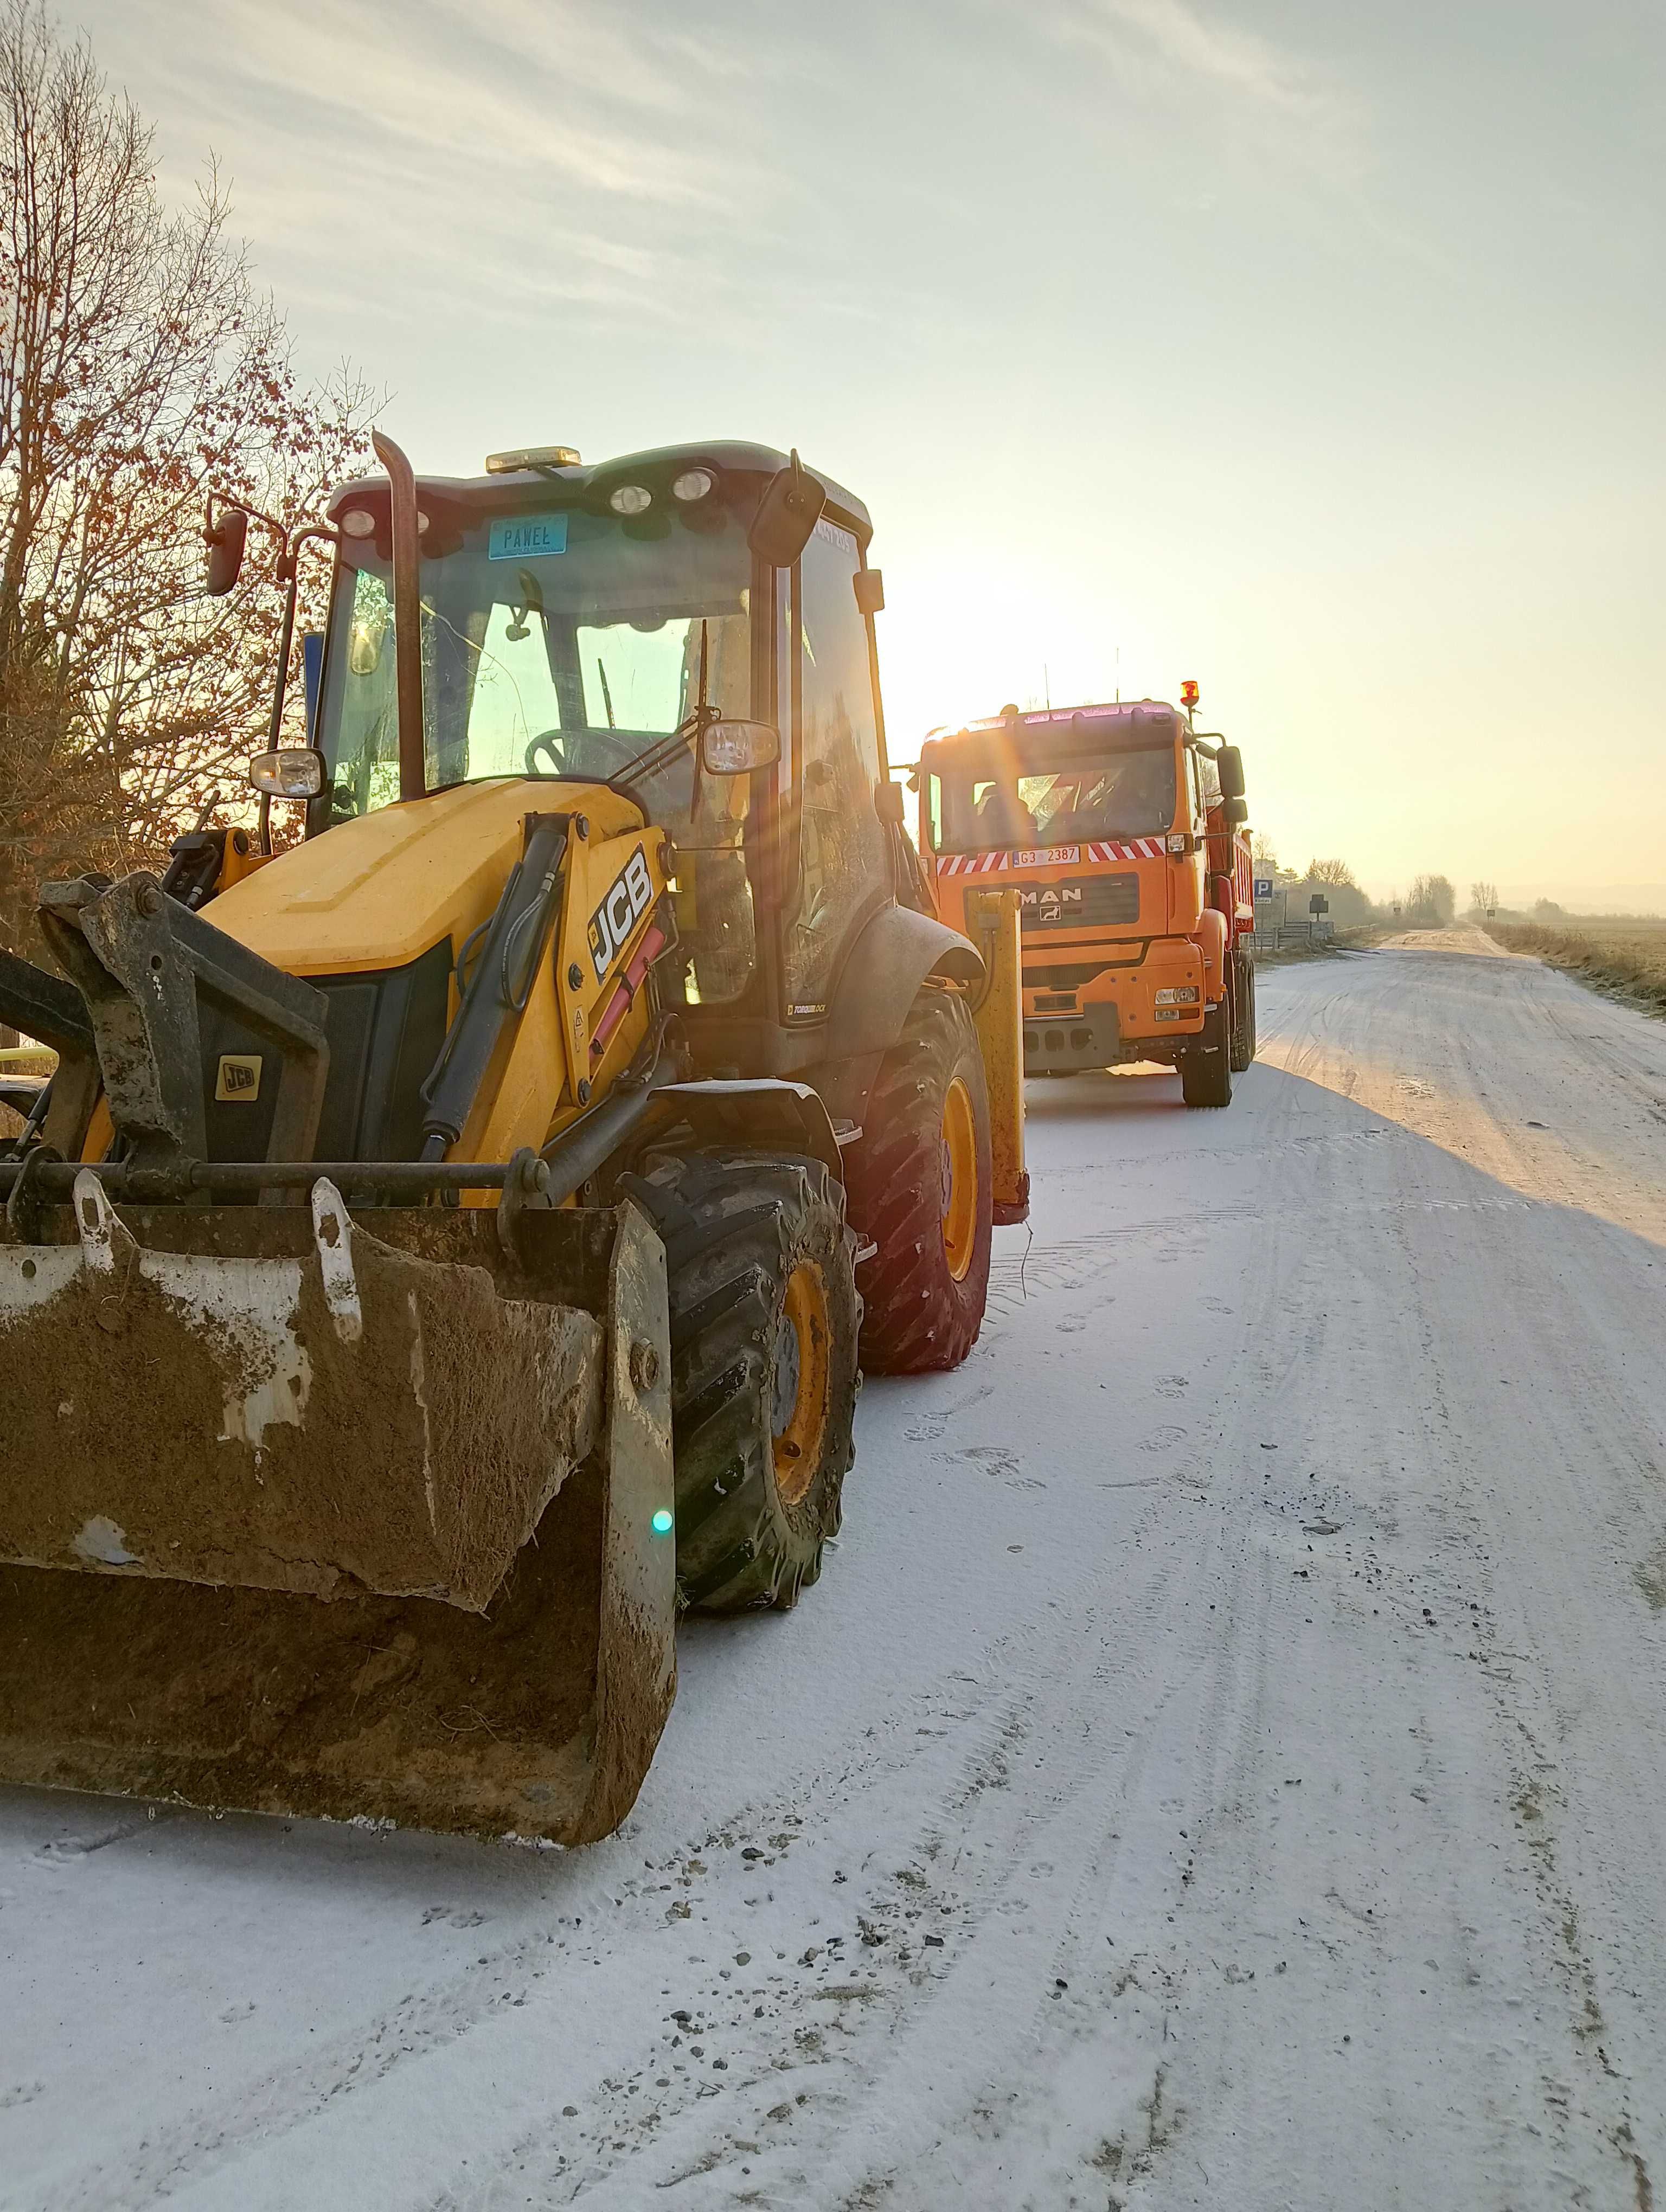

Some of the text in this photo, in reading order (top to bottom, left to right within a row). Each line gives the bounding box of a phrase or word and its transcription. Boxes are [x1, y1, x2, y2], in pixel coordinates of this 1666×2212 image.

[504, 526, 550, 549] PAWEŁ
[834, 529, 850, 553] 205
[1021, 848, 1075, 863] G3 2387
[1021, 888, 1081, 904] MAN
[1258, 881, 1269, 895] P
[594, 852, 651, 974] JCB
[227, 1066, 252, 1089] JCB
